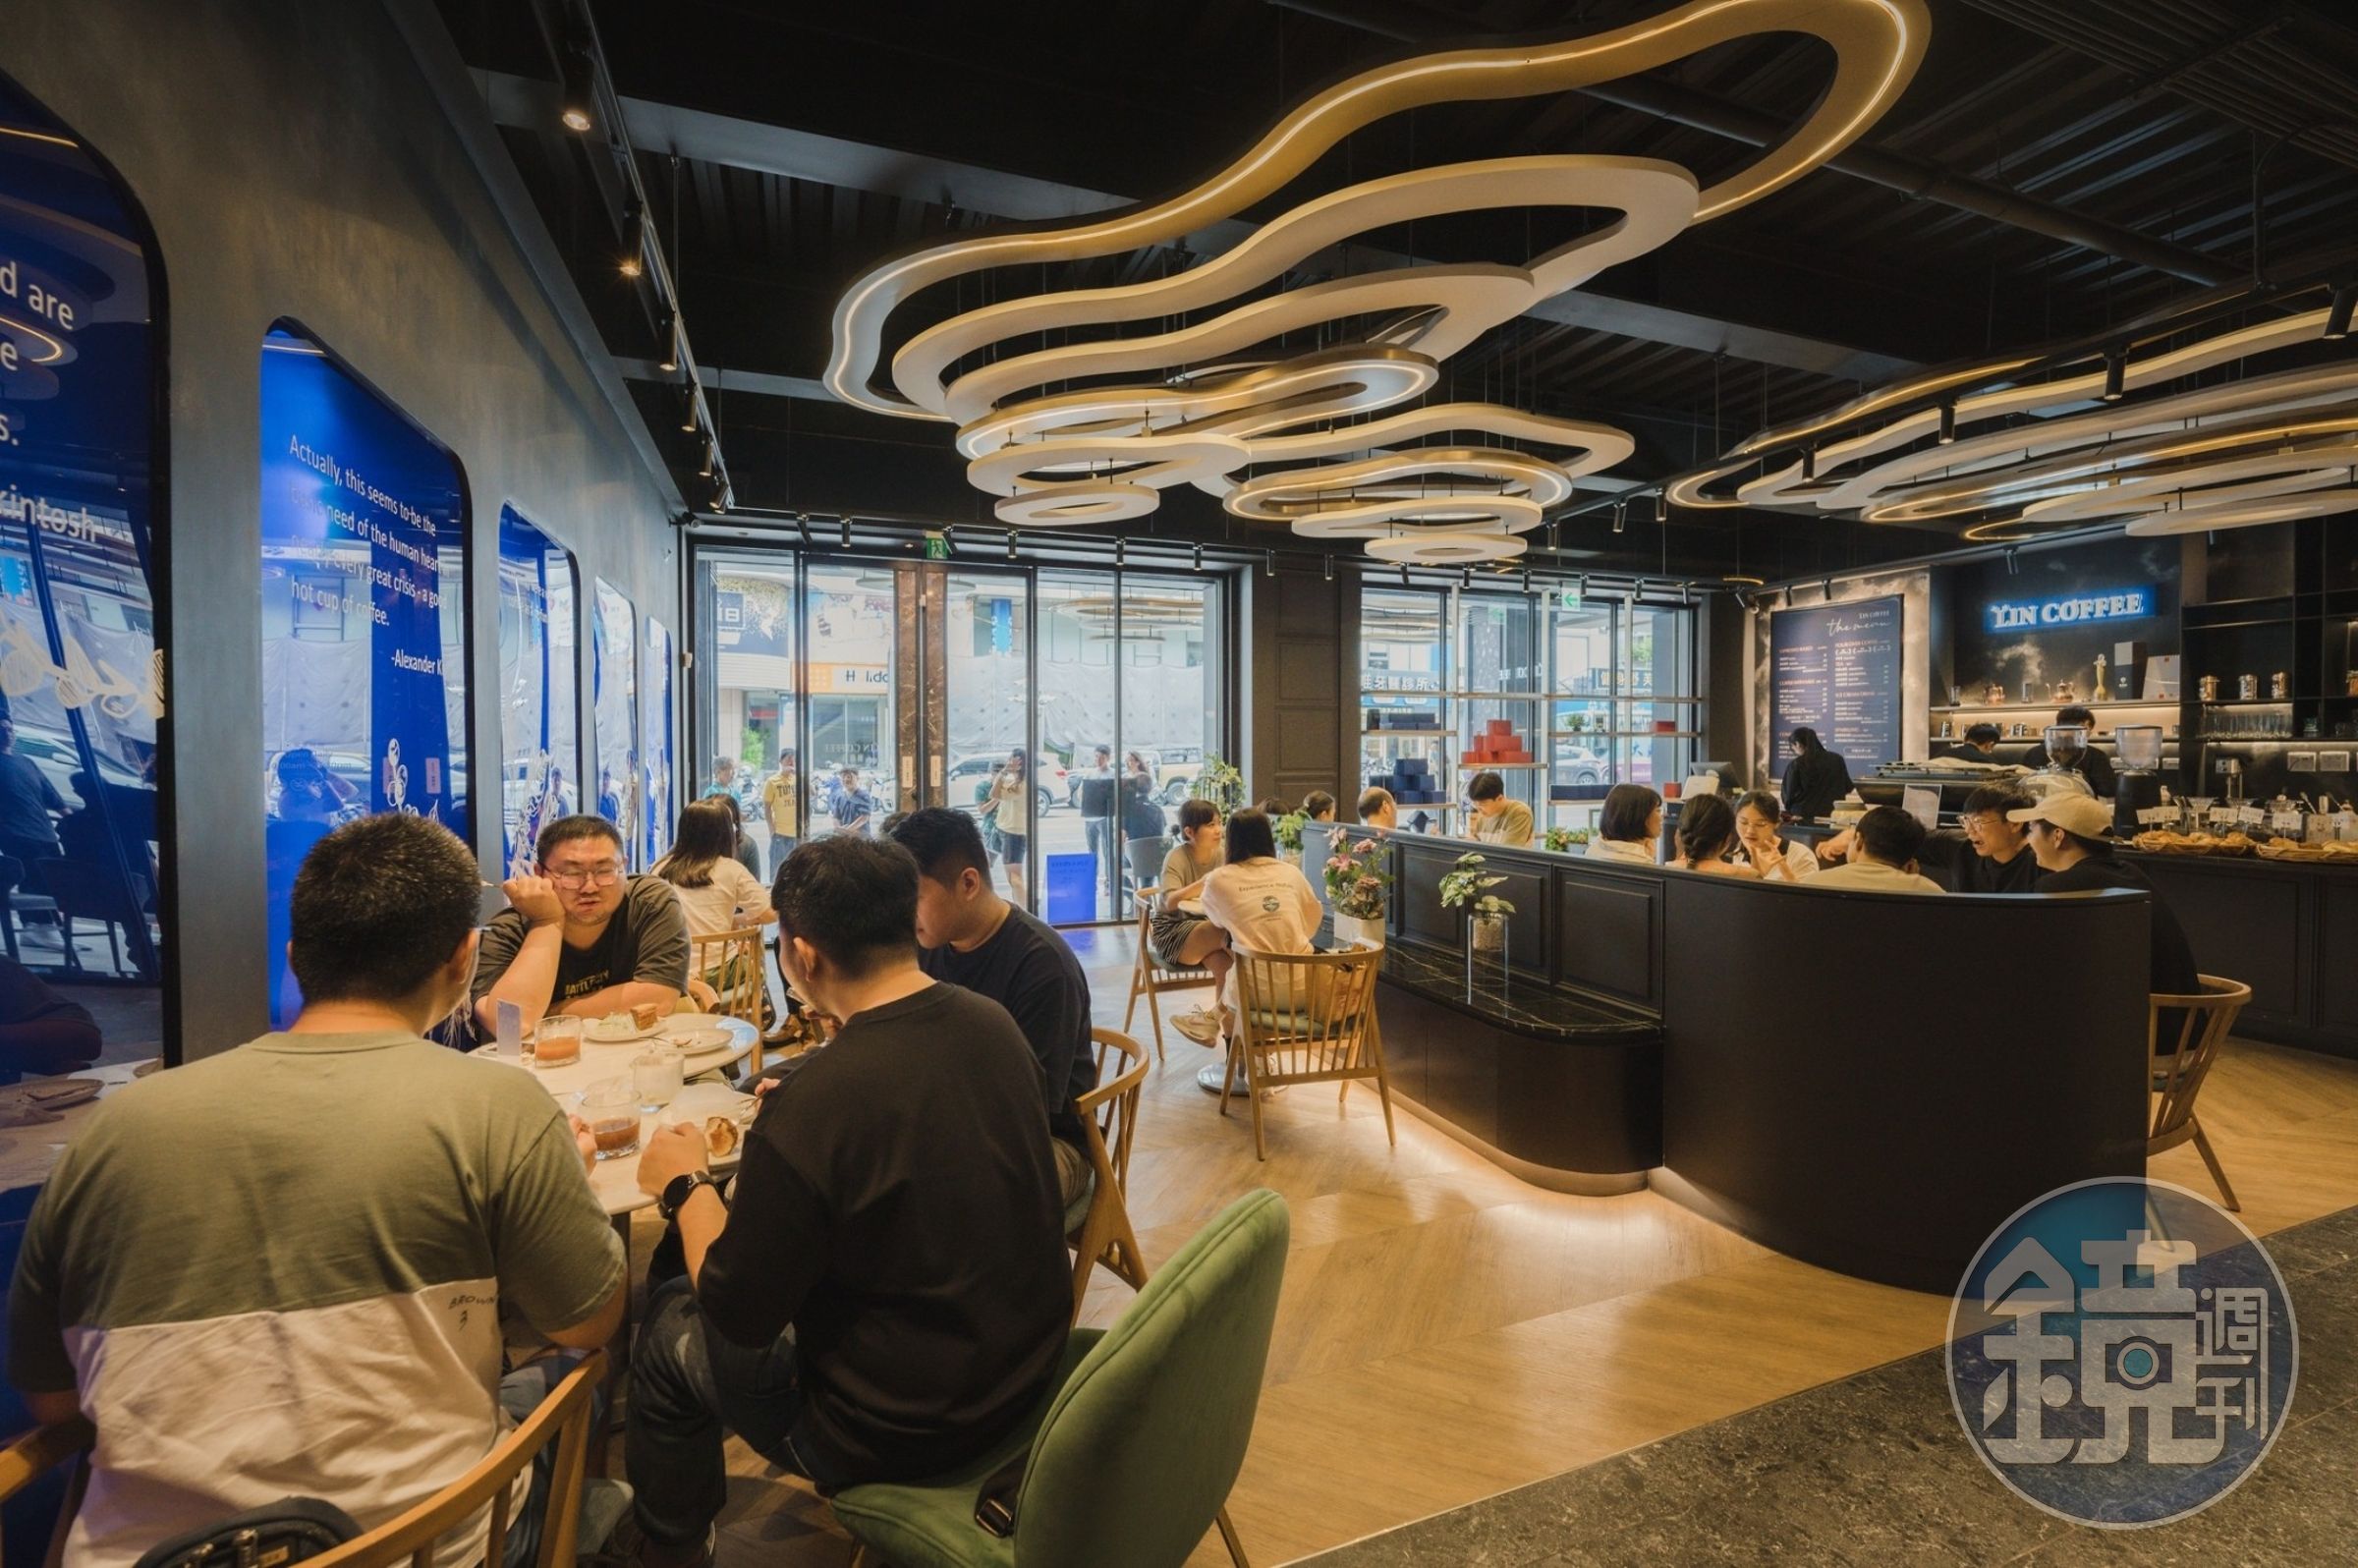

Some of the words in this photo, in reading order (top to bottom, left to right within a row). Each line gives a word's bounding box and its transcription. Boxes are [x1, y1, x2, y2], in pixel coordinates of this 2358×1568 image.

[28, 284, 74, 330] are
[289, 434, 343, 486] Actually,
[345, 469, 365, 496] this
[367, 485, 398, 515] seems
[400, 501, 410, 521] to
[411, 506, 421, 529] be
[422, 515, 436, 536] the
[326, 504, 355, 532] need
[357, 518, 368, 537] of
[370, 525, 387, 547] the
[389, 531, 420, 563] human
[421, 546, 441, 574] hear
[291, 575, 313, 604] hot
[315, 588, 339, 612] cup
[342, 593, 354, 615] of
[365, 566, 392, 589] great
[393, 577, 416, 598] crisis
[422, 589, 427, 602] a
[2042, 592, 2145, 623] COFFEE
[391, 648, 435, 675] -Alexander
